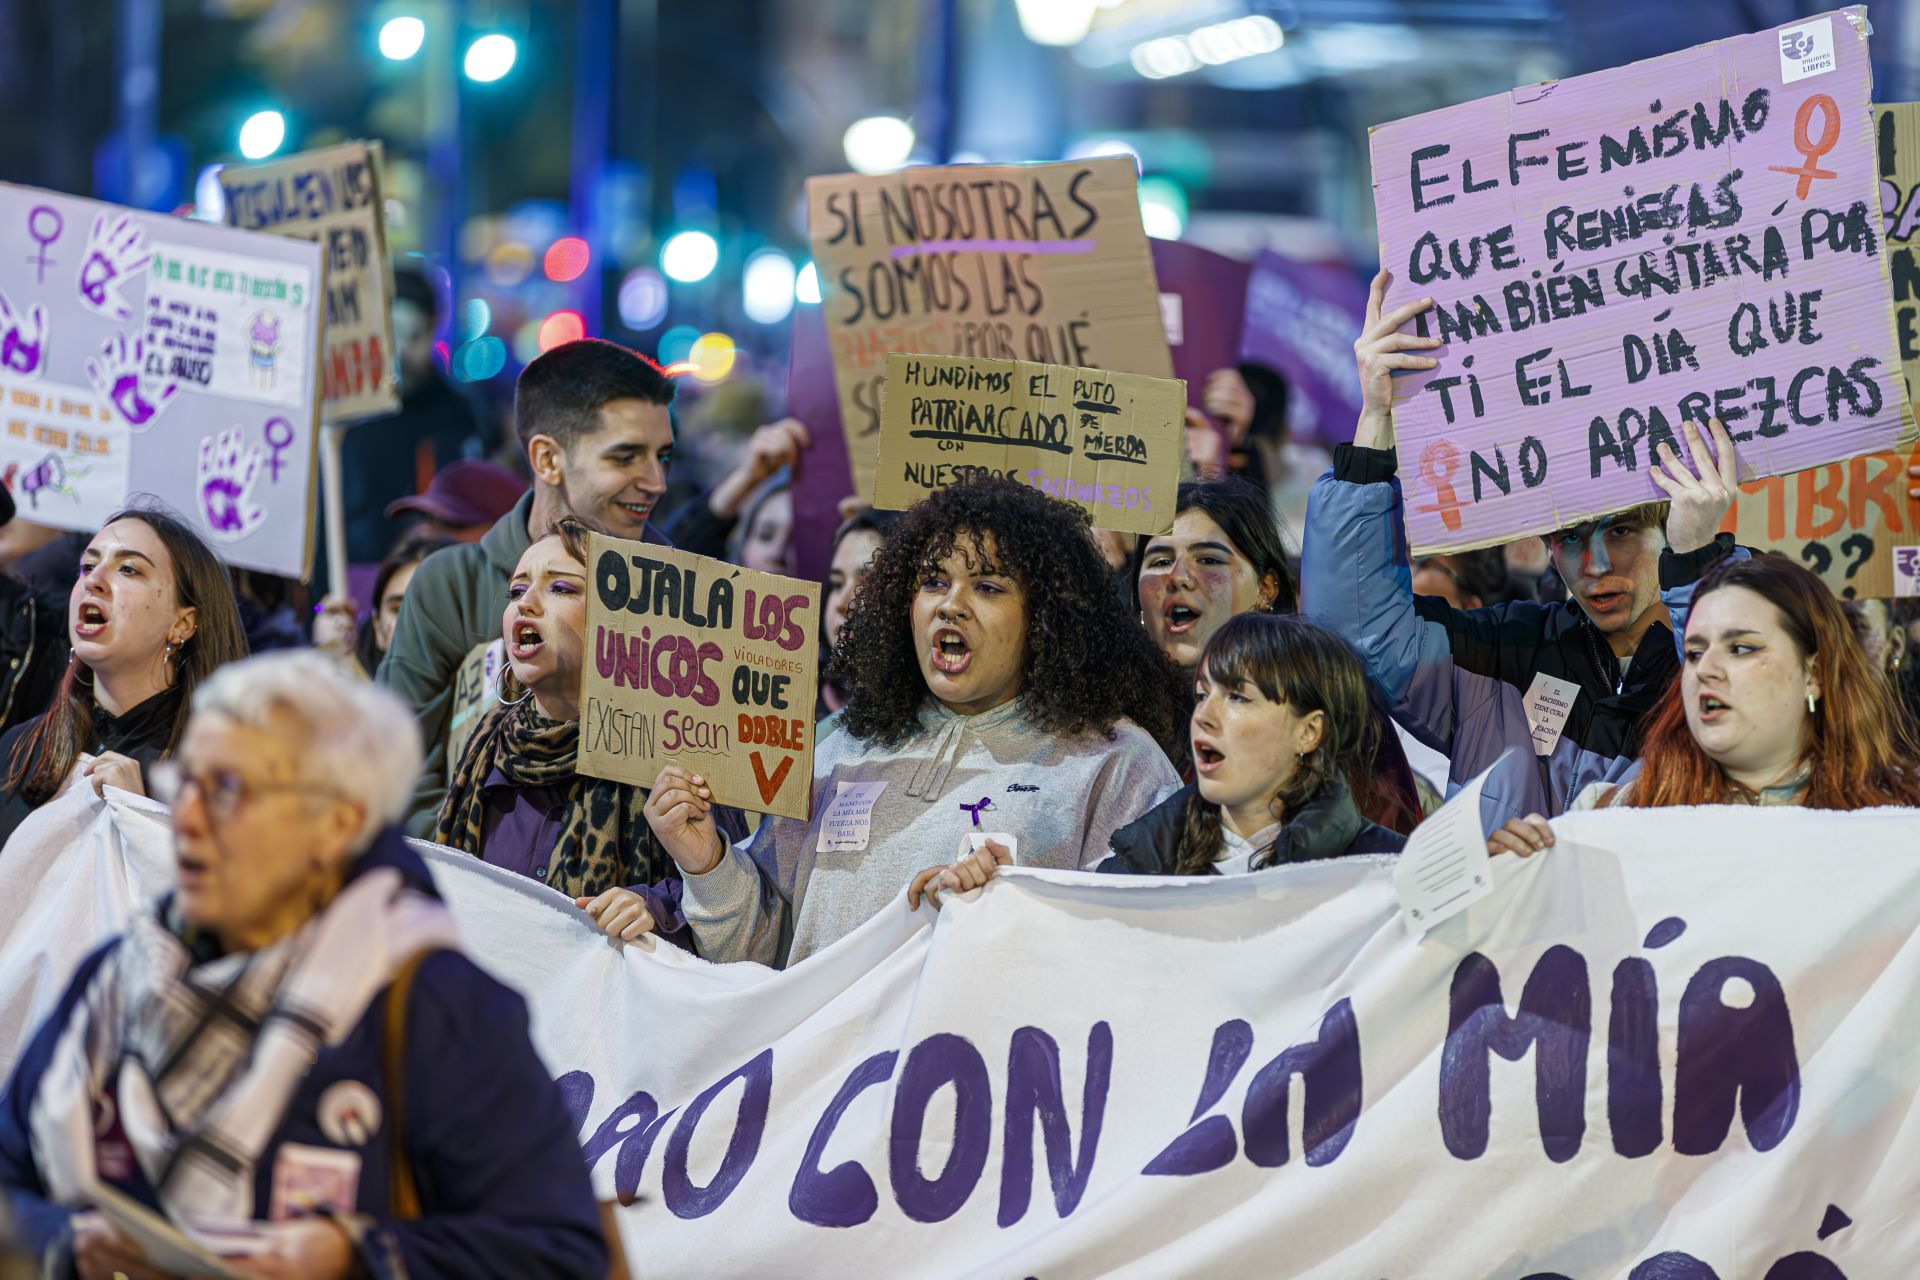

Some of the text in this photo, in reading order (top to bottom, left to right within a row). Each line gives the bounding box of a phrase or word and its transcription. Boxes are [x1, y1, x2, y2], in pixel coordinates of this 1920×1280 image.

[1411, 144, 1499, 213] EL
[827, 169, 1099, 247] SI NOSOTRAS
[1801, 200, 1879, 260] POR
[1409, 224, 1520, 286] QUE
[839, 252, 1042, 326] SOMOS LAS
[1024, 311, 1101, 369] QUÉ
[1515, 347, 1593, 406] EL
[1622, 306, 1700, 384] DÍA
[1728, 289, 1823, 357] QUE
[1029, 374, 1057, 398] EL
[1073, 379, 1115, 405] PUTO
[1080, 412, 1100, 430] DE
[1470, 354, 1883, 503] NO APAREZCAS
[938, 440, 964, 452] CON
[596, 549, 810, 651] OJALÁ LOS
[732, 665, 791, 710] QUE
[1534, 703, 1550, 714] TIENE
[1540, 694, 1569, 709] MACHISMO
[737, 713, 805, 751] DOBLE
[1542, 716, 1549, 724] LA
[749, 751, 794, 806] V
[828, 820, 853, 828] FUERZA
[838, 800, 858, 808] MANO
[841, 808, 854, 817] MÍA
[855, 807, 870, 815] MÁS
[837, 828, 856, 838] DARÁ
[788, 1020, 1114, 1229] CON
[1438, 916, 1801, 1164] MÍA
